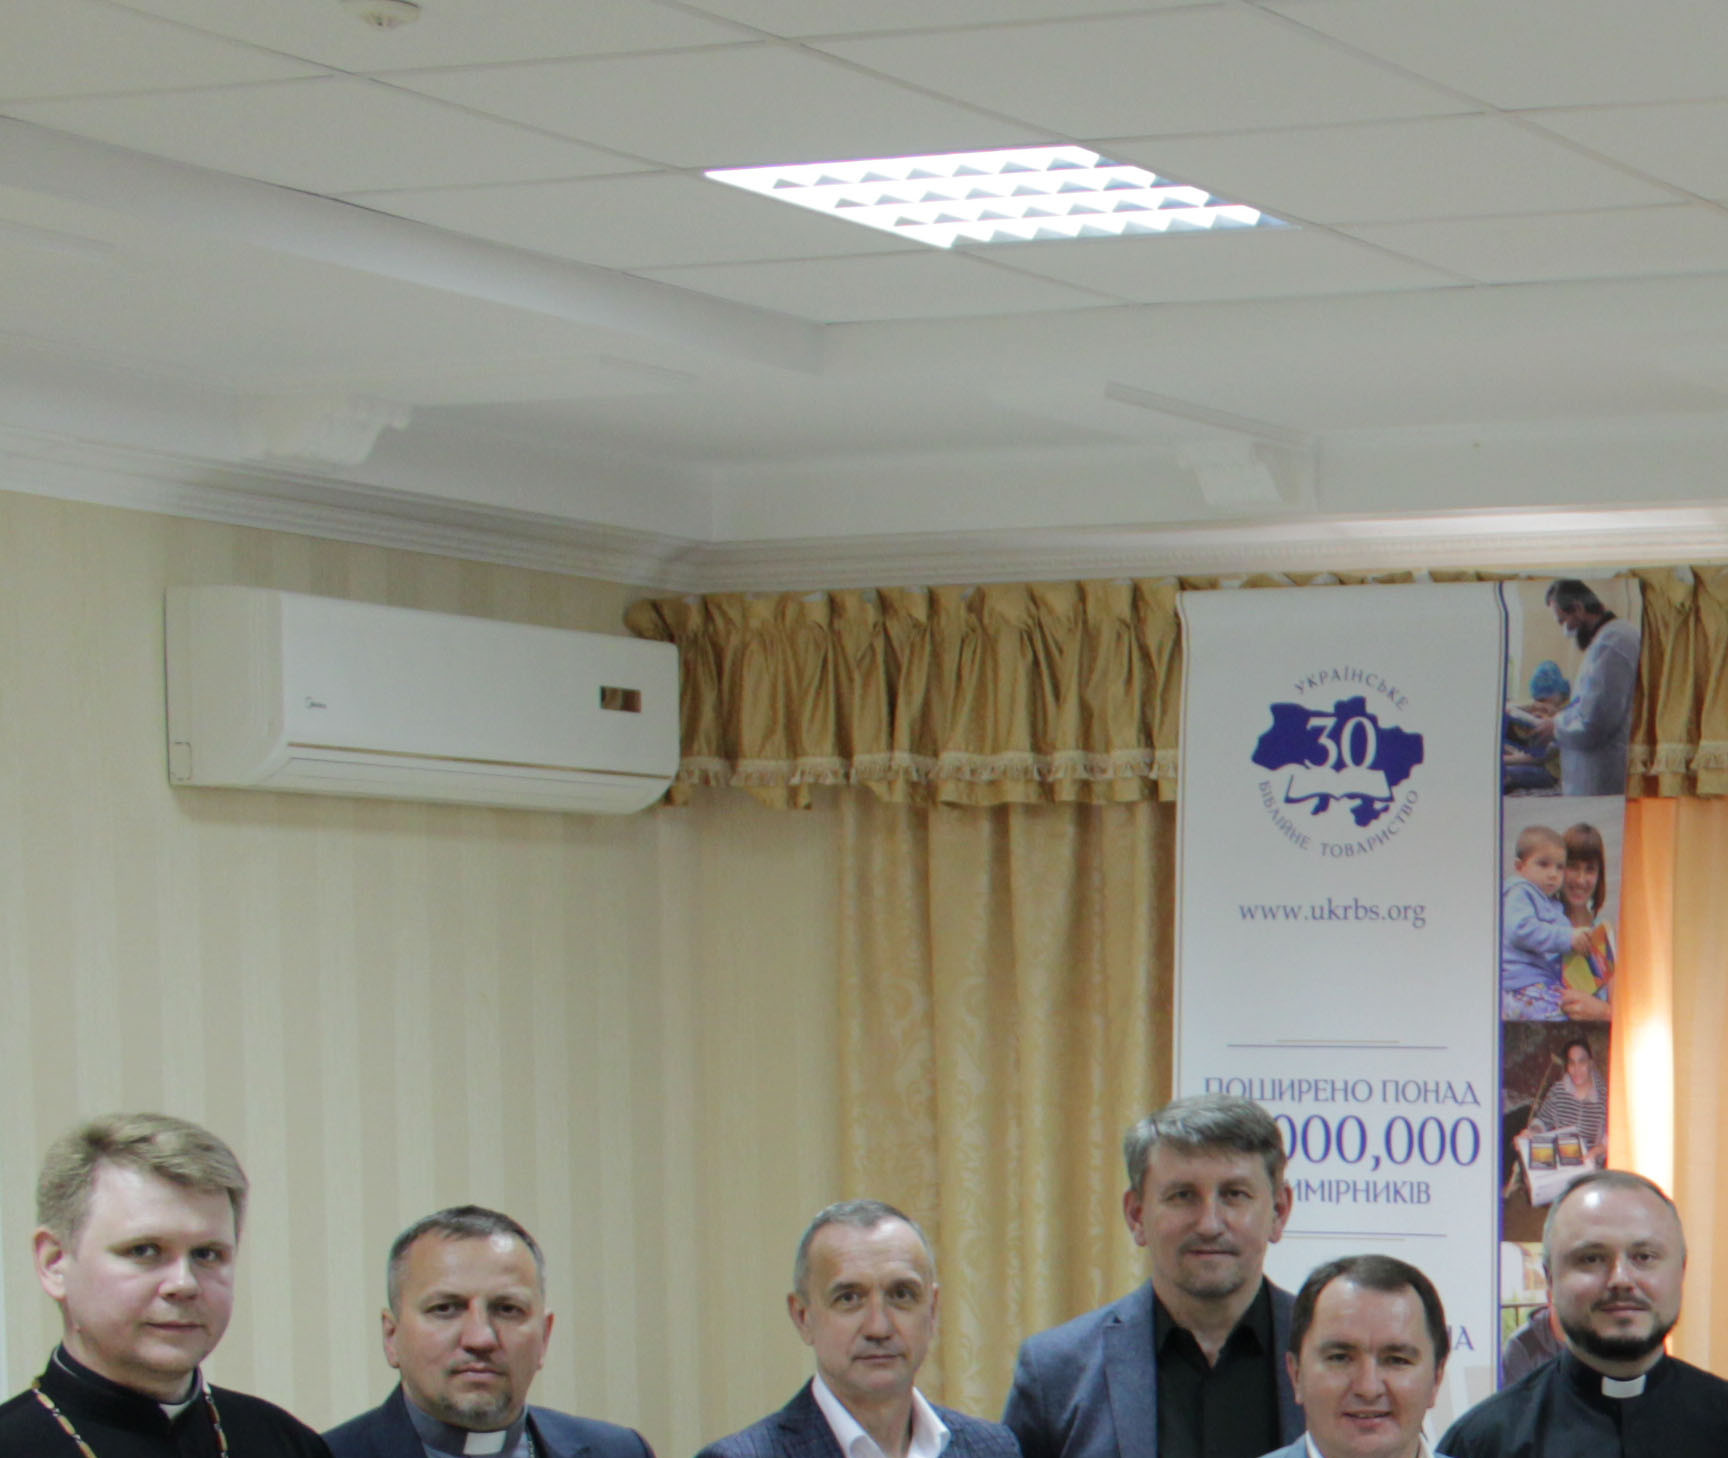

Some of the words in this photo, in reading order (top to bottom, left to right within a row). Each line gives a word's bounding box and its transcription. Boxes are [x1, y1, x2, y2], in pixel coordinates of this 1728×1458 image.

[1293, 665, 1410, 711] УКРАЇНСЬКЕ
[1304, 716, 1377, 770] 30
[1258, 780, 1312, 850] БІБЛІЙНЕ
[1320, 789, 1419, 858] ТОВАРИСТВО
[1239, 898, 1427, 929] www.ukrbs.org
[1204, 1077, 1373, 1104] ПОШИРЕНО
[1382, 1079, 1481, 1107] ПОНАД
[1274, 1114, 1480, 1172] 000,000
